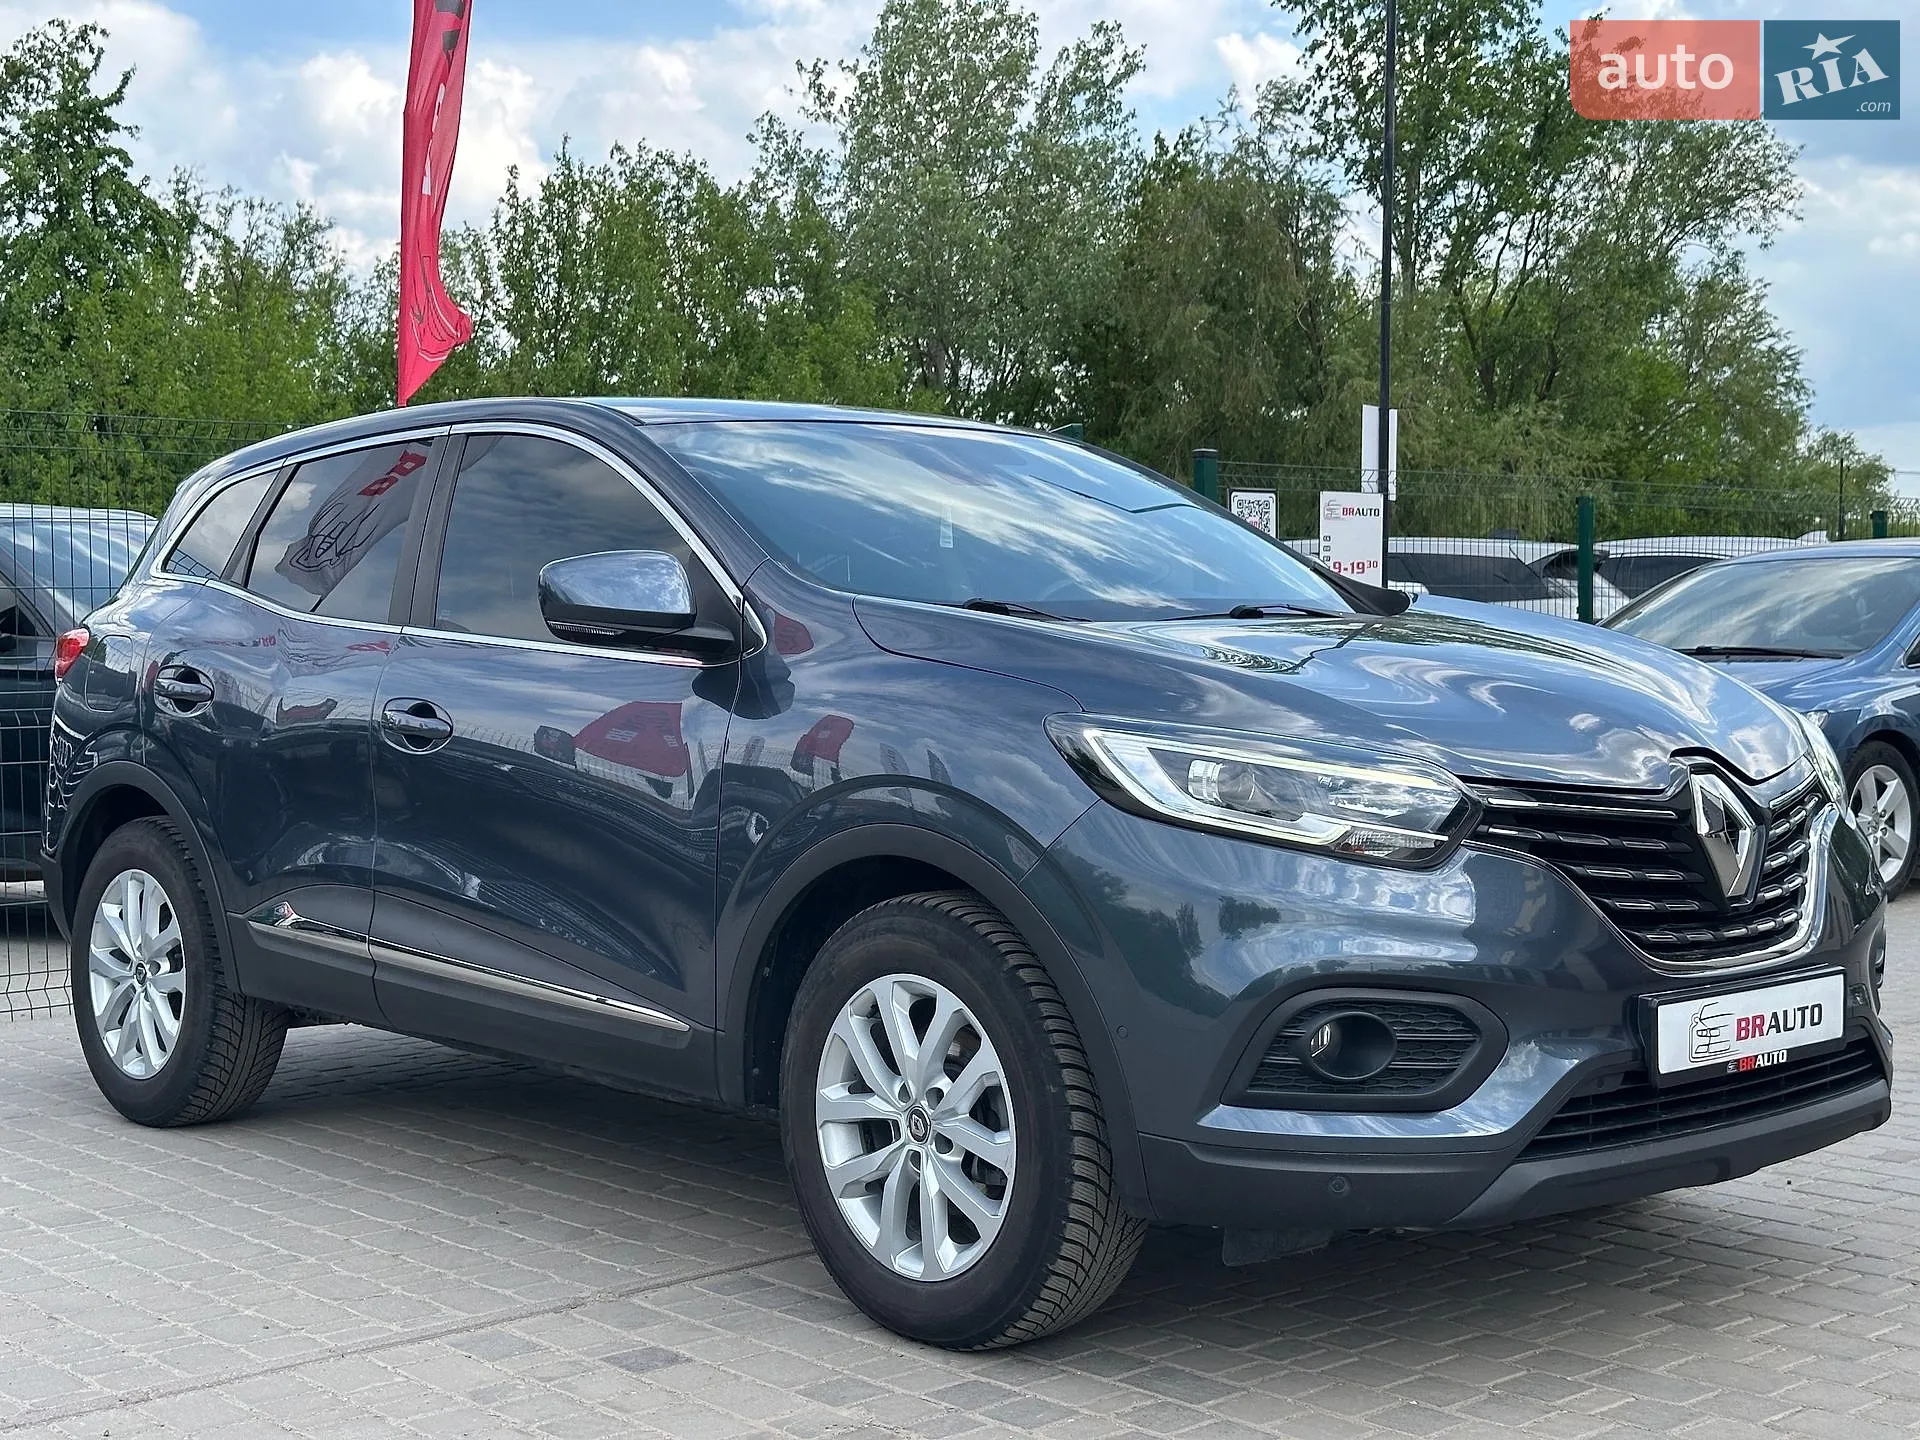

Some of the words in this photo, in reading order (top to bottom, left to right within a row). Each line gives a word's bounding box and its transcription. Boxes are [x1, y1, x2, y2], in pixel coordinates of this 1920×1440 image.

[1342, 507, 1380, 517] BRAUTO
[1735, 1003, 1823, 1042] BRAUTO
[1738, 1050, 1788, 1072] BRAUTO
